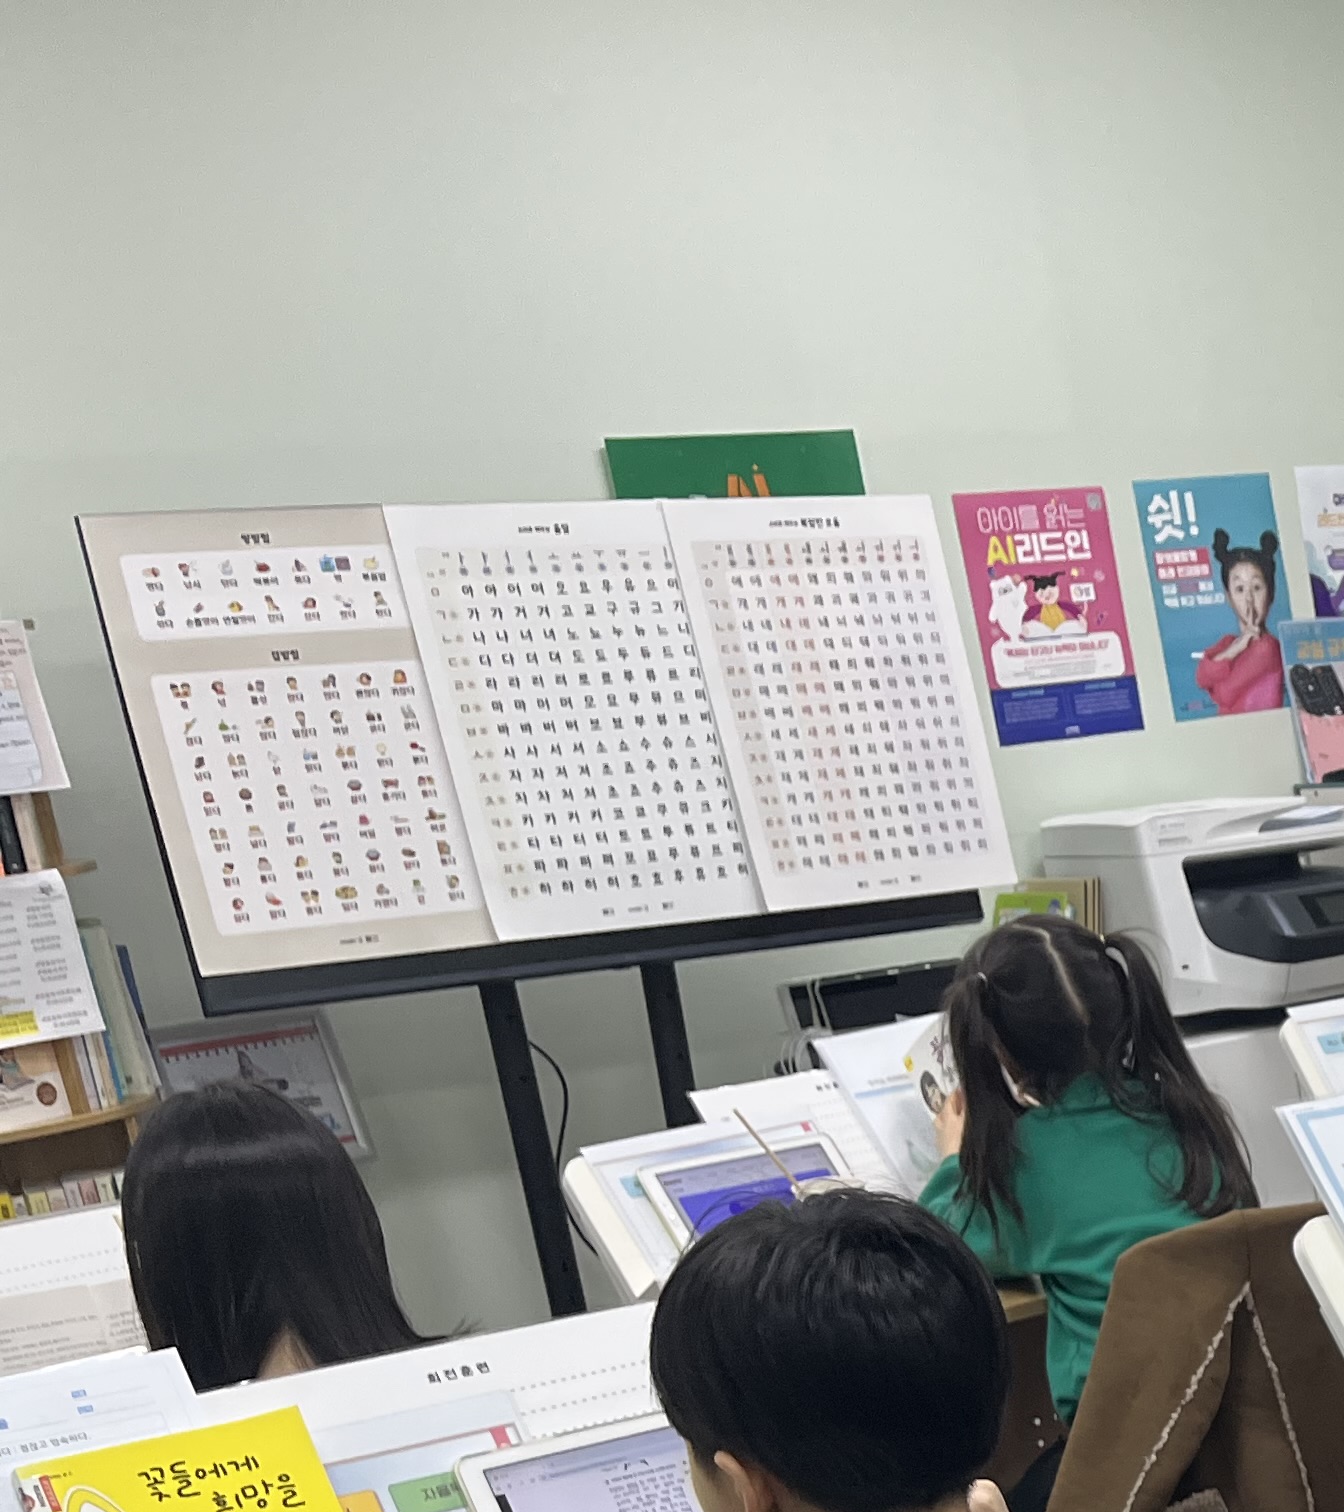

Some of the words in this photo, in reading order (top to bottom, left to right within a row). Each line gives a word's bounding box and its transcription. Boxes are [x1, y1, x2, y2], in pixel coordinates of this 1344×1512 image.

[977, 504, 1040, 533] 아이를
[1147, 490, 1200, 544] 쉿!
[987, 530, 1092, 566] AI리드인
[138, 1455, 260, 1503] 꽃들에게
